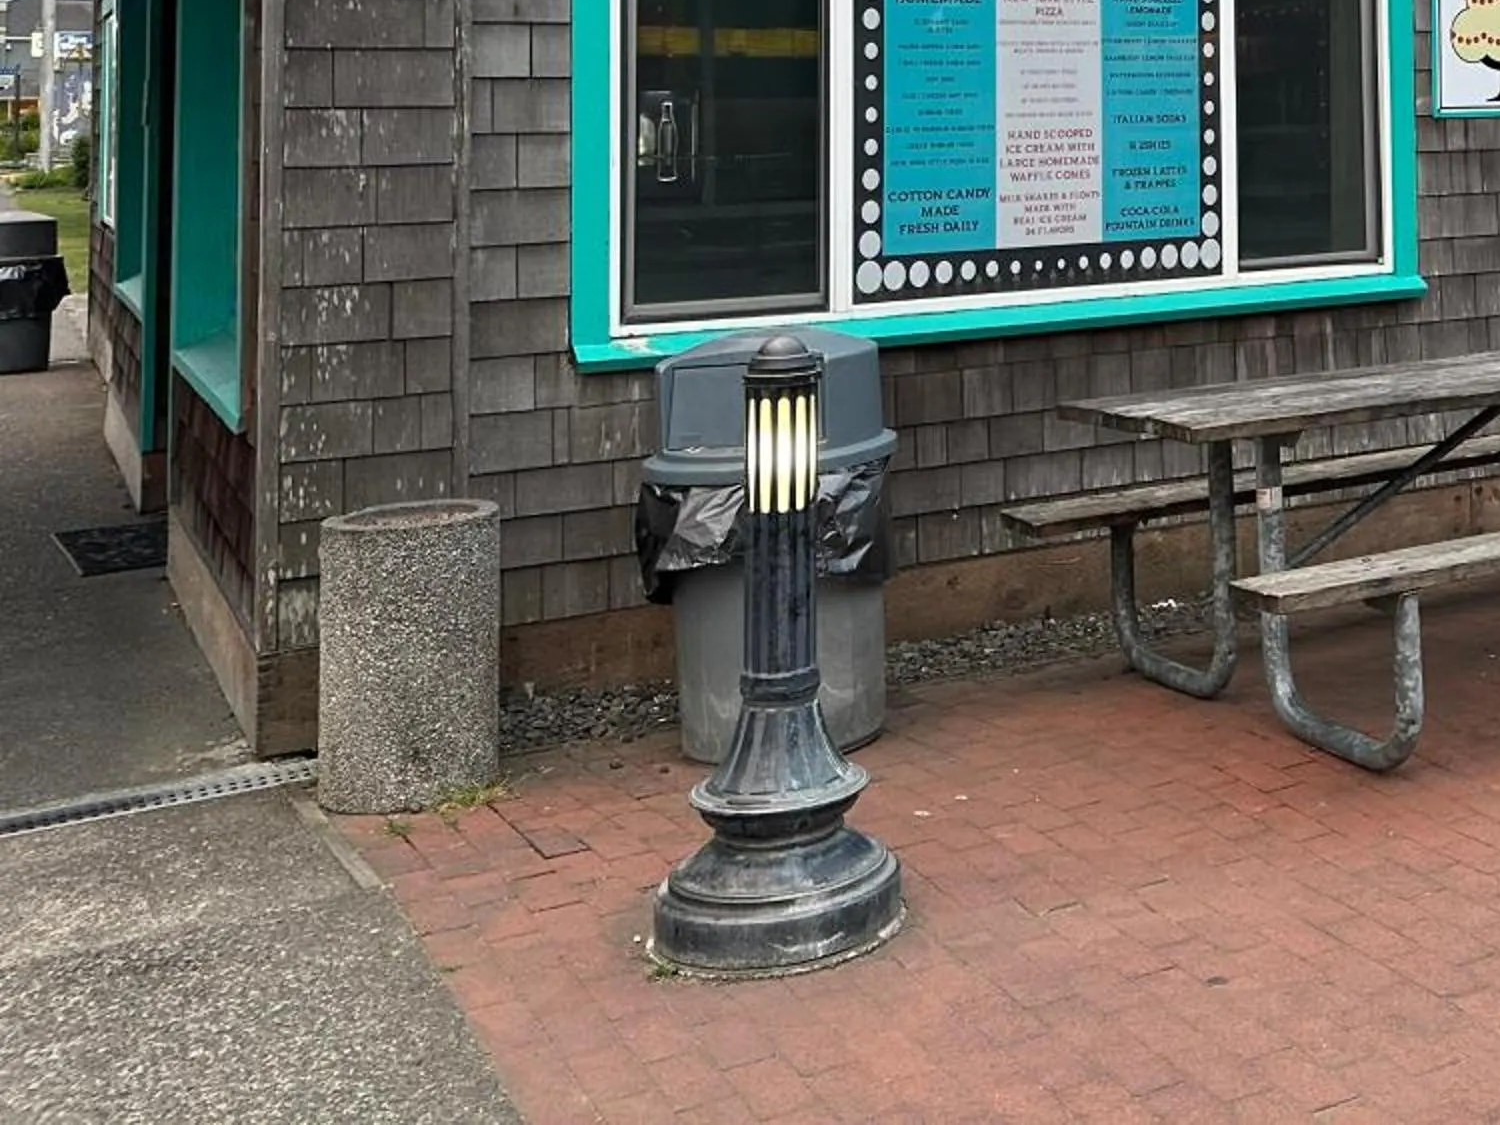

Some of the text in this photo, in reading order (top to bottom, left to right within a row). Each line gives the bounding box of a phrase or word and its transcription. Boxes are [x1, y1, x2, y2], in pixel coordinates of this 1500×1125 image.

[1035, 6, 1063, 16] PIZZA
[1126, 6, 1173, 15] LEMONADE
[1113, 113, 1187, 124] ITALIAN SODAS
[1008, 128, 1093, 140] HAND SCOOPED
[1006, 142, 1096, 155] ICE CREAM WITH
[1000, 157, 1035, 168] LARGE
[1039, 155, 1100, 167] HOMEMADE
[1010, 169, 1091, 182] WAFFLE CONES
[888, 187, 992, 203] COTTON CANDY
[921, 205, 960, 218] MADE
[1053, 203, 1077, 213] WITH
[1038, 215, 1053, 225] ICE
[1054, 213, 1087, 224] CREAM
[1105, 216, 1195, 232] FOUNTAIN DRINKS
[900, 219, 979, 235] FRESH DAILY
